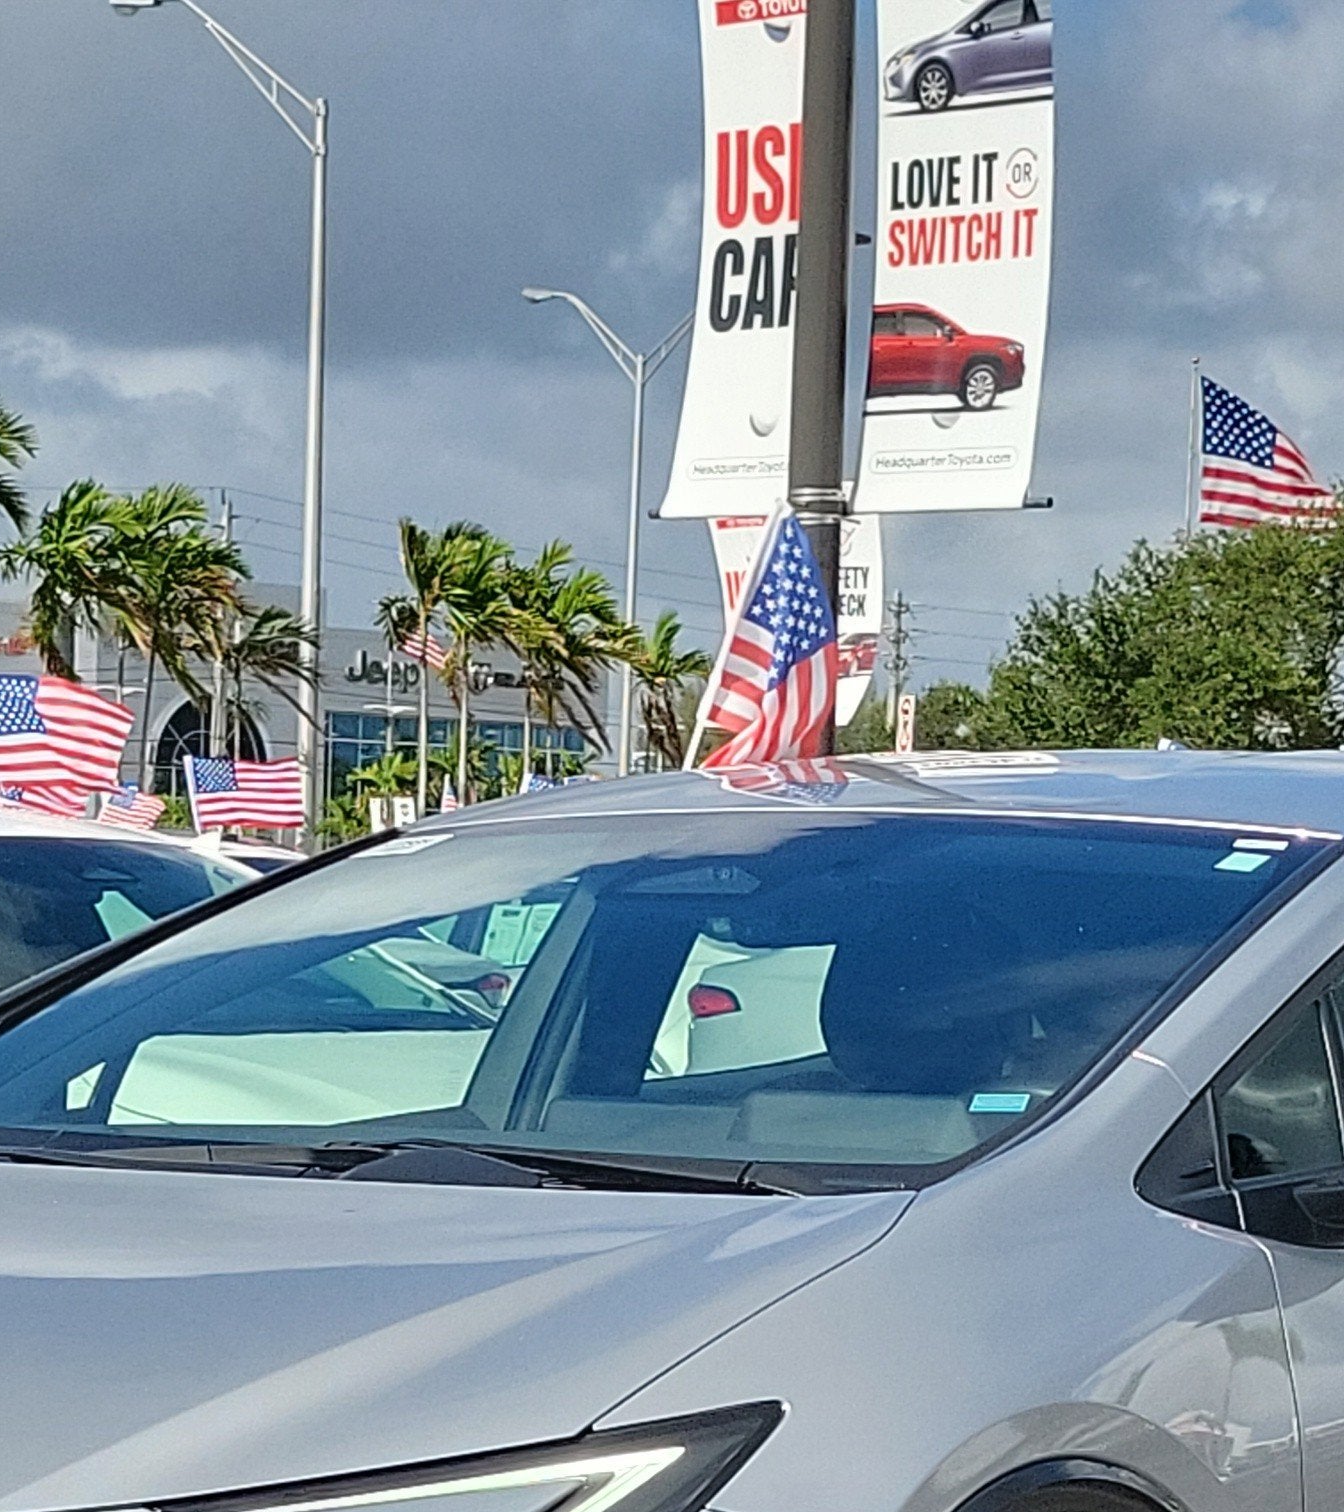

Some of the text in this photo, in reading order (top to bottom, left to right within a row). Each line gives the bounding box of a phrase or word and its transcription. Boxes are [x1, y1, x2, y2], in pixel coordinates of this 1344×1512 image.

[717, 123, 802, 229] US
[891, 152, 1032, 210] LOVE IT OR
[888, 208, 1038, 267] SWITCH IT
[709, 233, 797, 332] CA
[345, 650, 421, 694] Jeep
